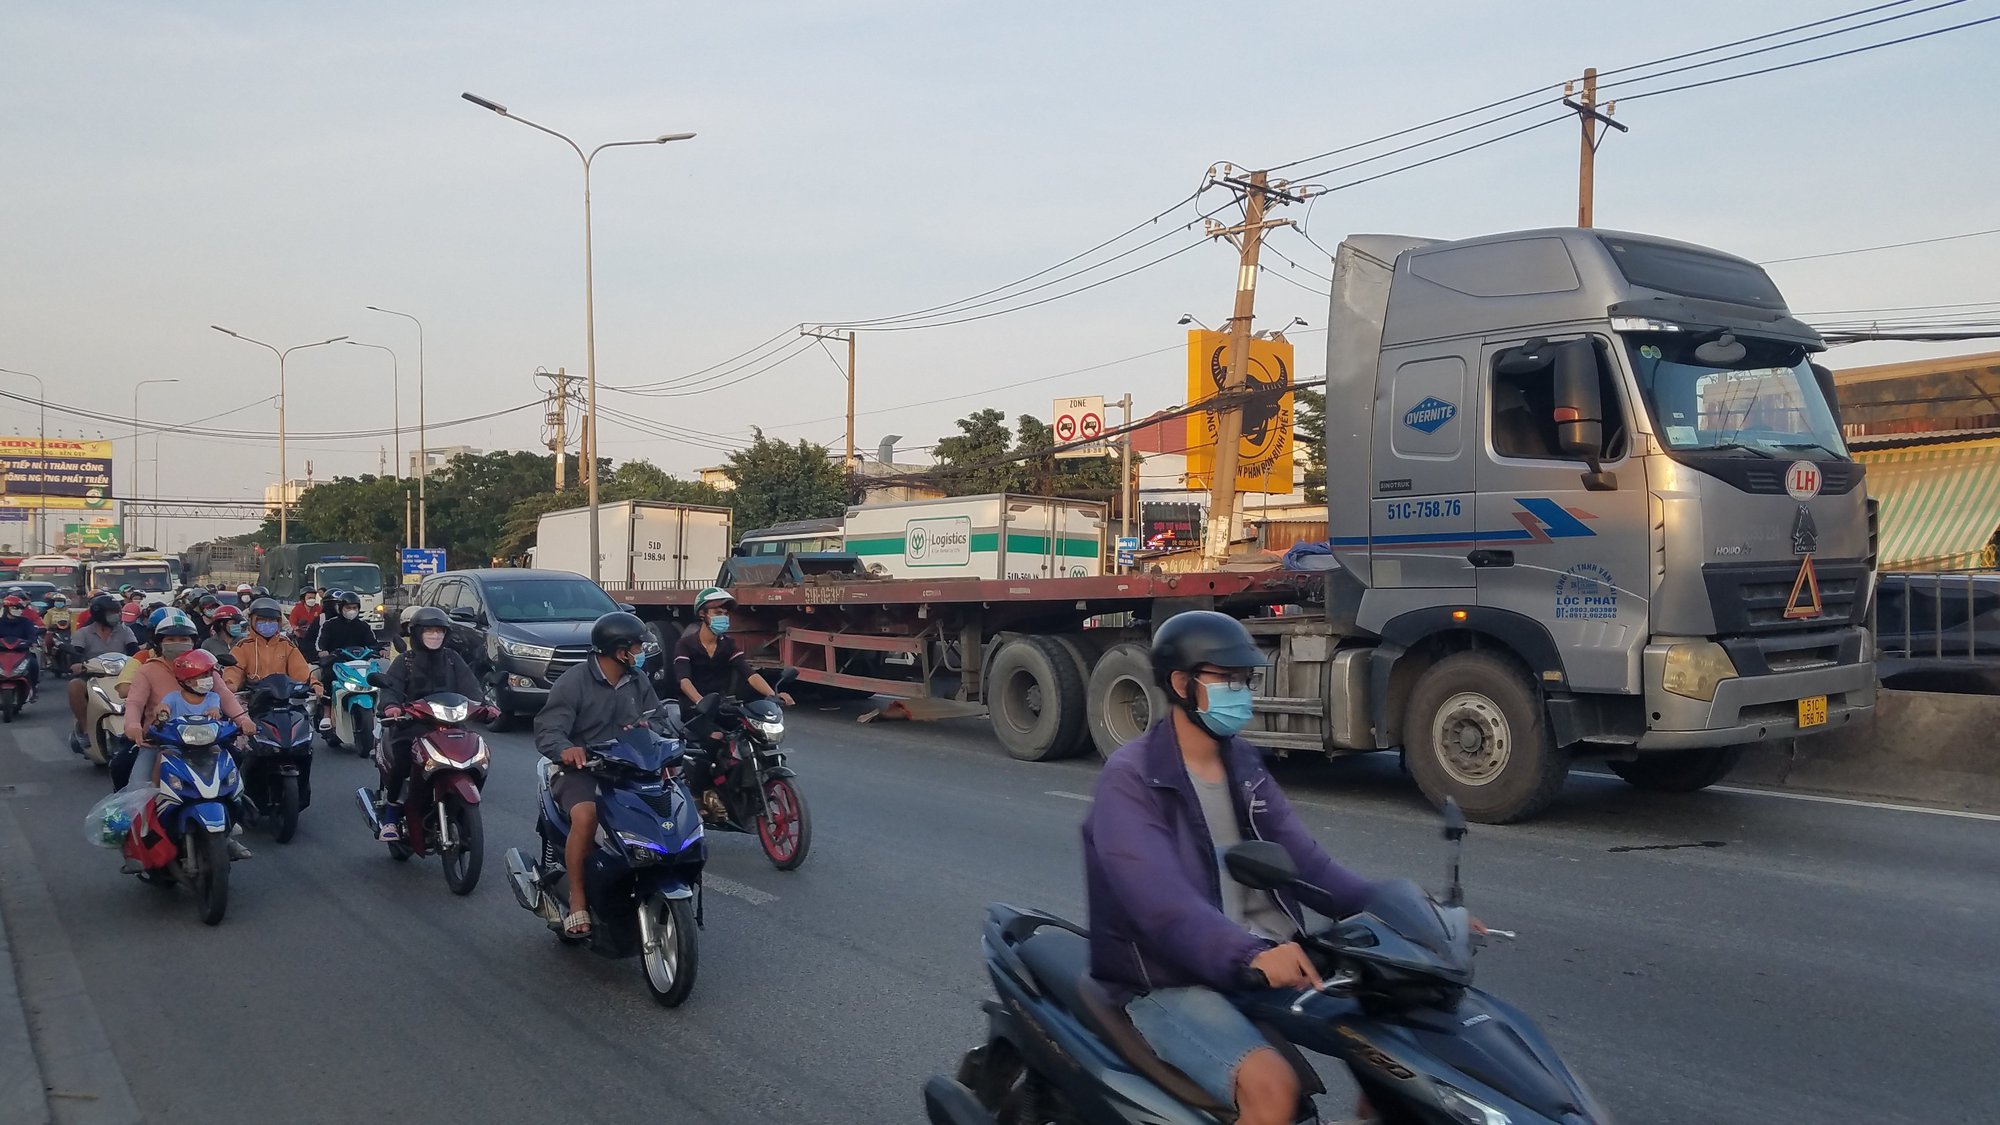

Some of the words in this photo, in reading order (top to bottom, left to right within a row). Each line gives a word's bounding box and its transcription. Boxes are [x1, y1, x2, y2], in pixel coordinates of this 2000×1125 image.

[1069, 399, 1087, 408] ZONE
[1206, 408, 1220, 432] ÔNG
[1406, 405, 1453, 425] OVERNITE
[1271, 434, 1286, 460] BÌNH
[50, 461, 79, 471] THÀNH
[80, 462, 104, 472] CÔNG
[61, 474, 84, 483] PHÁT
[1796, 470, 1816, 491] LH
[1387, 499, 1461, 520] 51C-758.76
[648, 541, 662, 550] 51D
[931, 531, 967, 548] Logistics
[643, 552, 666, 562] 198.94
[1806, 699, 1820, 712] 51C
[1802, 711, 1824, 726] 758.76
